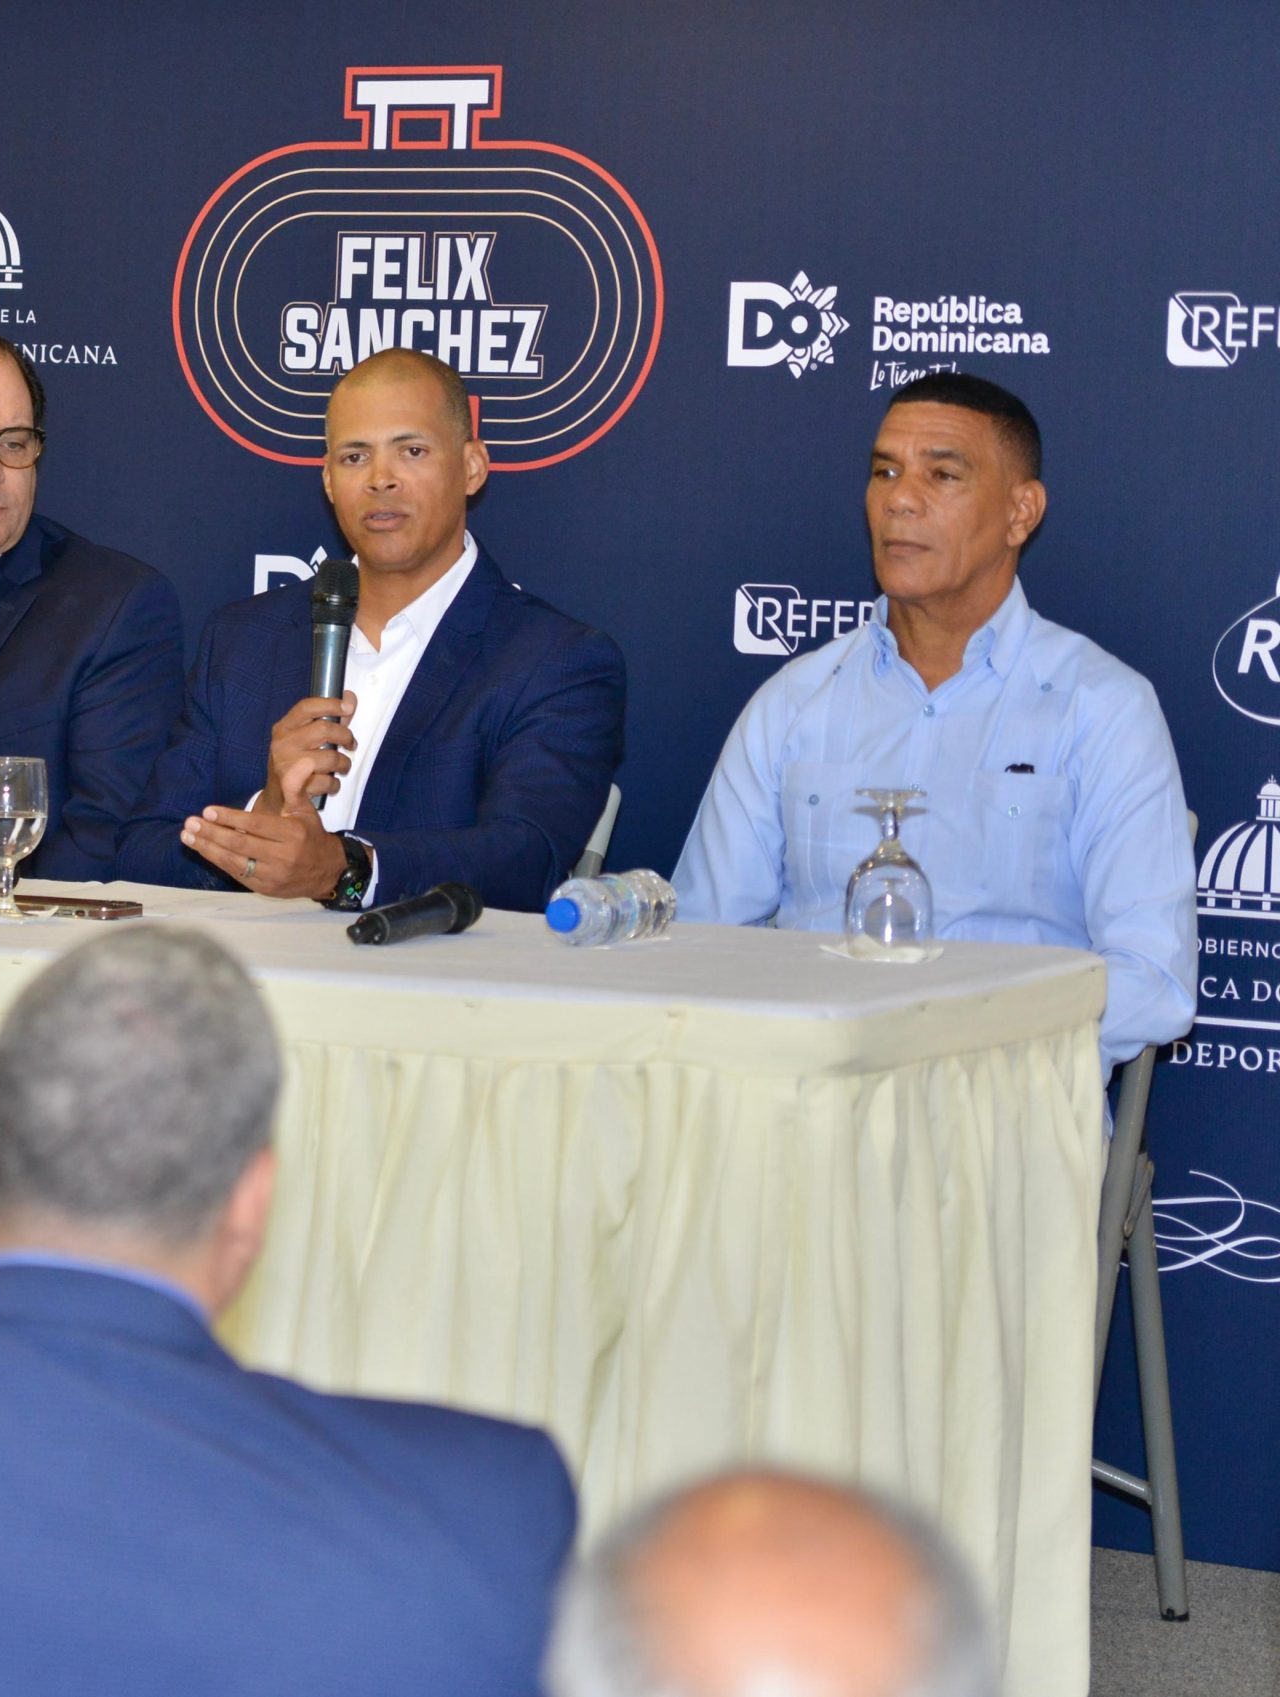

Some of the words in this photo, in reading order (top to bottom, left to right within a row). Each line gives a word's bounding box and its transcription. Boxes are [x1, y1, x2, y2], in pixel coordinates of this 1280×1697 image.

[339, 236, 490, 301] FELIX
[16, 310, 36, 323] LA
[873, 295, 1024, 330] República
[13, 343, 118, 365] NICANA
[284, 307, 542, 373] SANCHEZ
[872, 324, 1051, 354] Dominicana
[870, 360, 886, 391] Lo
[1170, 1040, 1280, 1073] DEPOR
